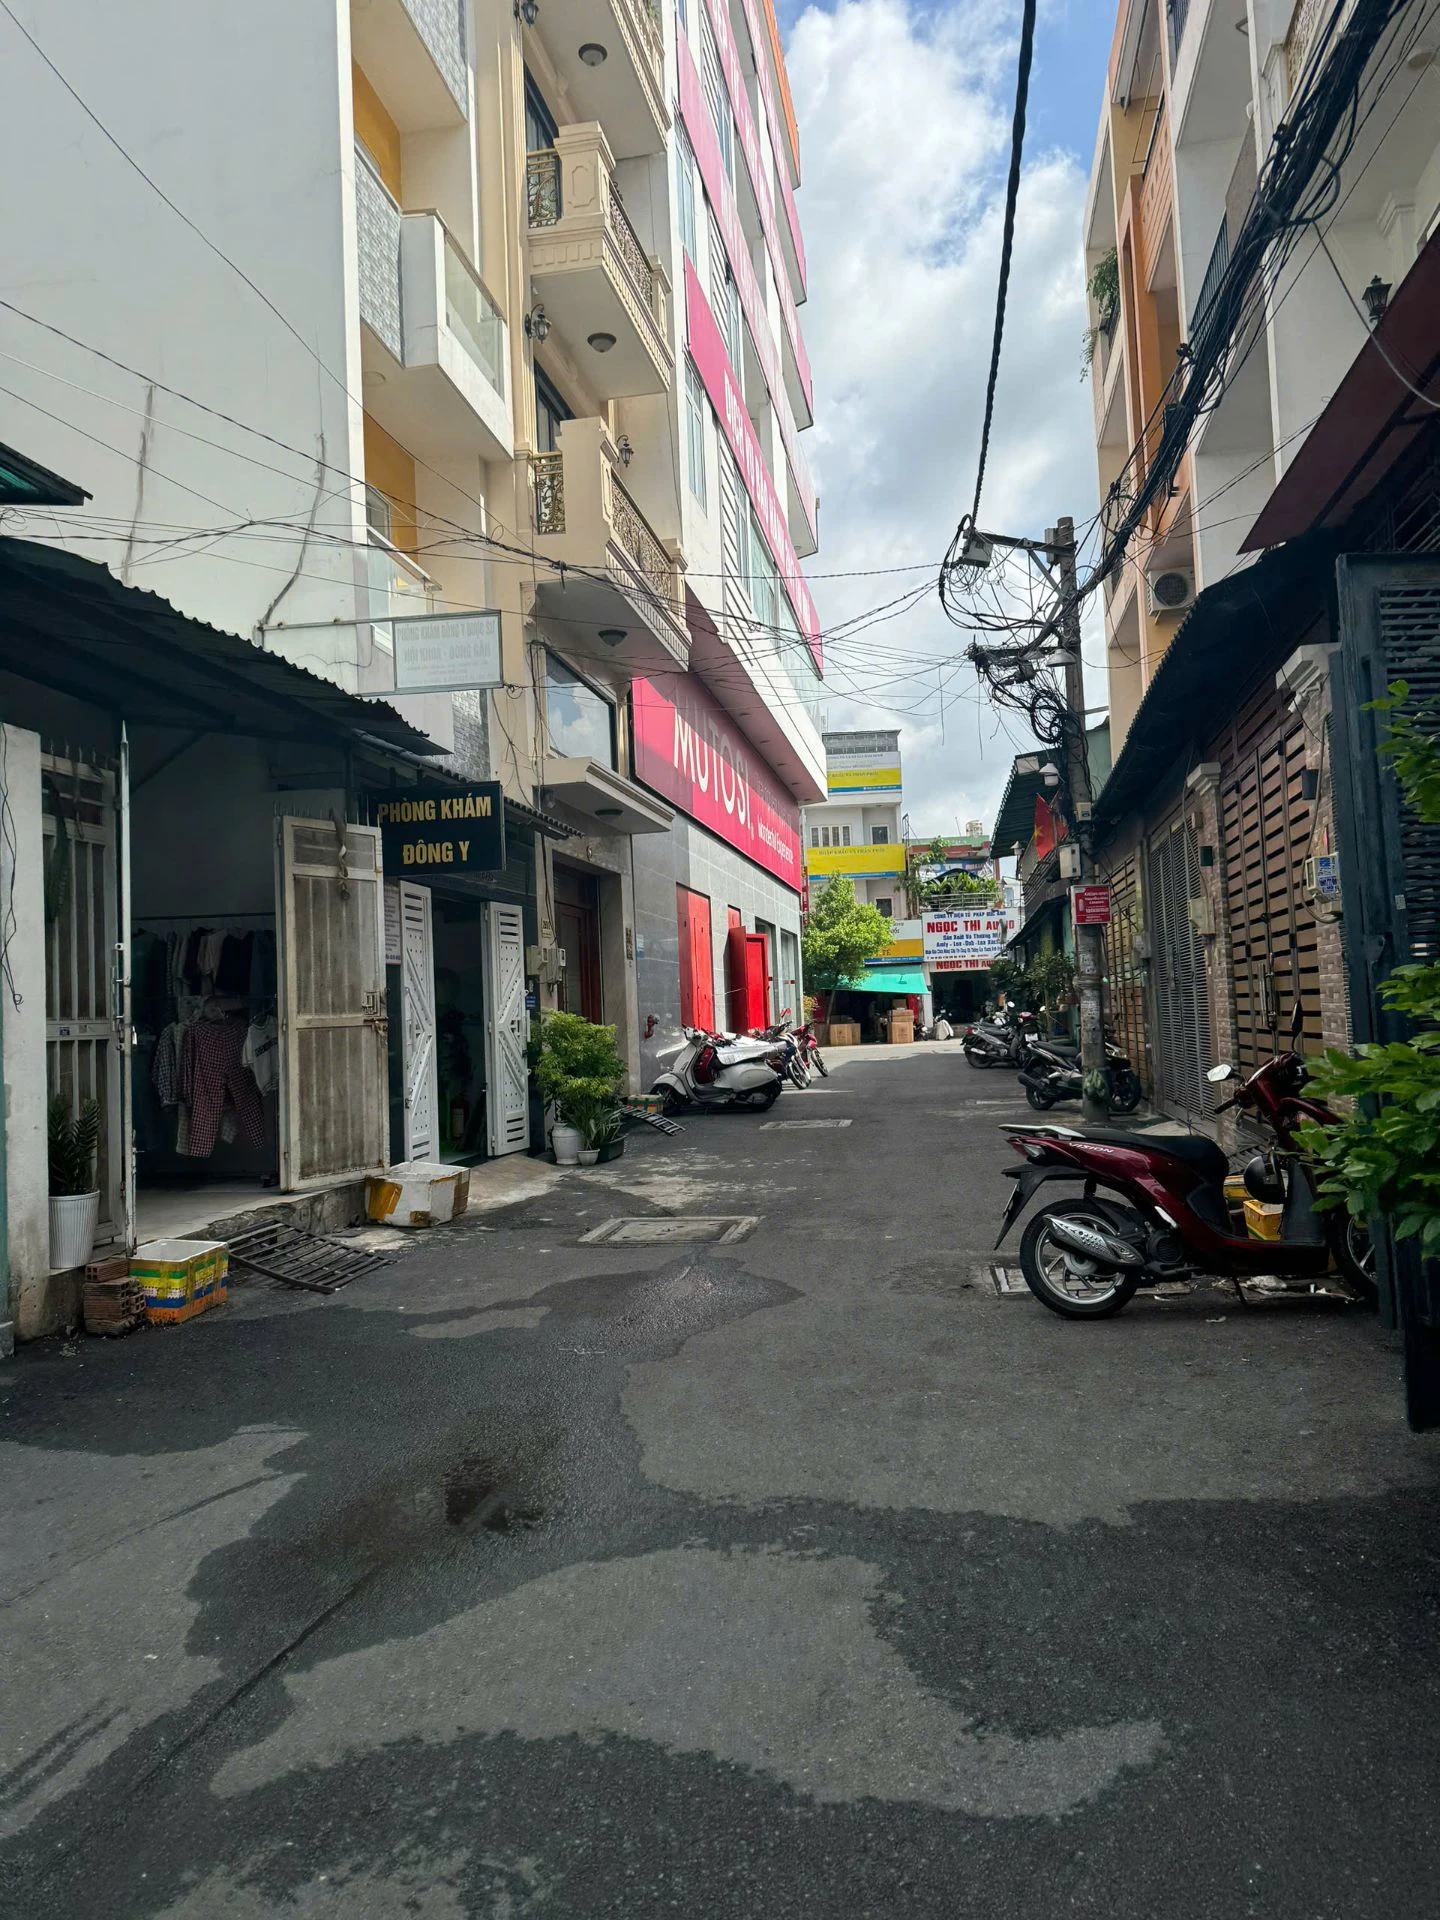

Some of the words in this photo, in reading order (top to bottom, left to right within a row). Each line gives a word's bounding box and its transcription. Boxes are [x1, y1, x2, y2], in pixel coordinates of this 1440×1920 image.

[673, 680, 750, 830] MUTOSI
[378, 797, 436, 823] PHÒNG
[441, 792, 492, 820] KHÁM
[402, 839, 454, 865] ĐÔNG
[458, 840, 470, 862] Y
[927, 922, 958, 934] NGỌC
[963, 920, 981, 932] THI
[1068, 1142, 1115, 1153] VISION
